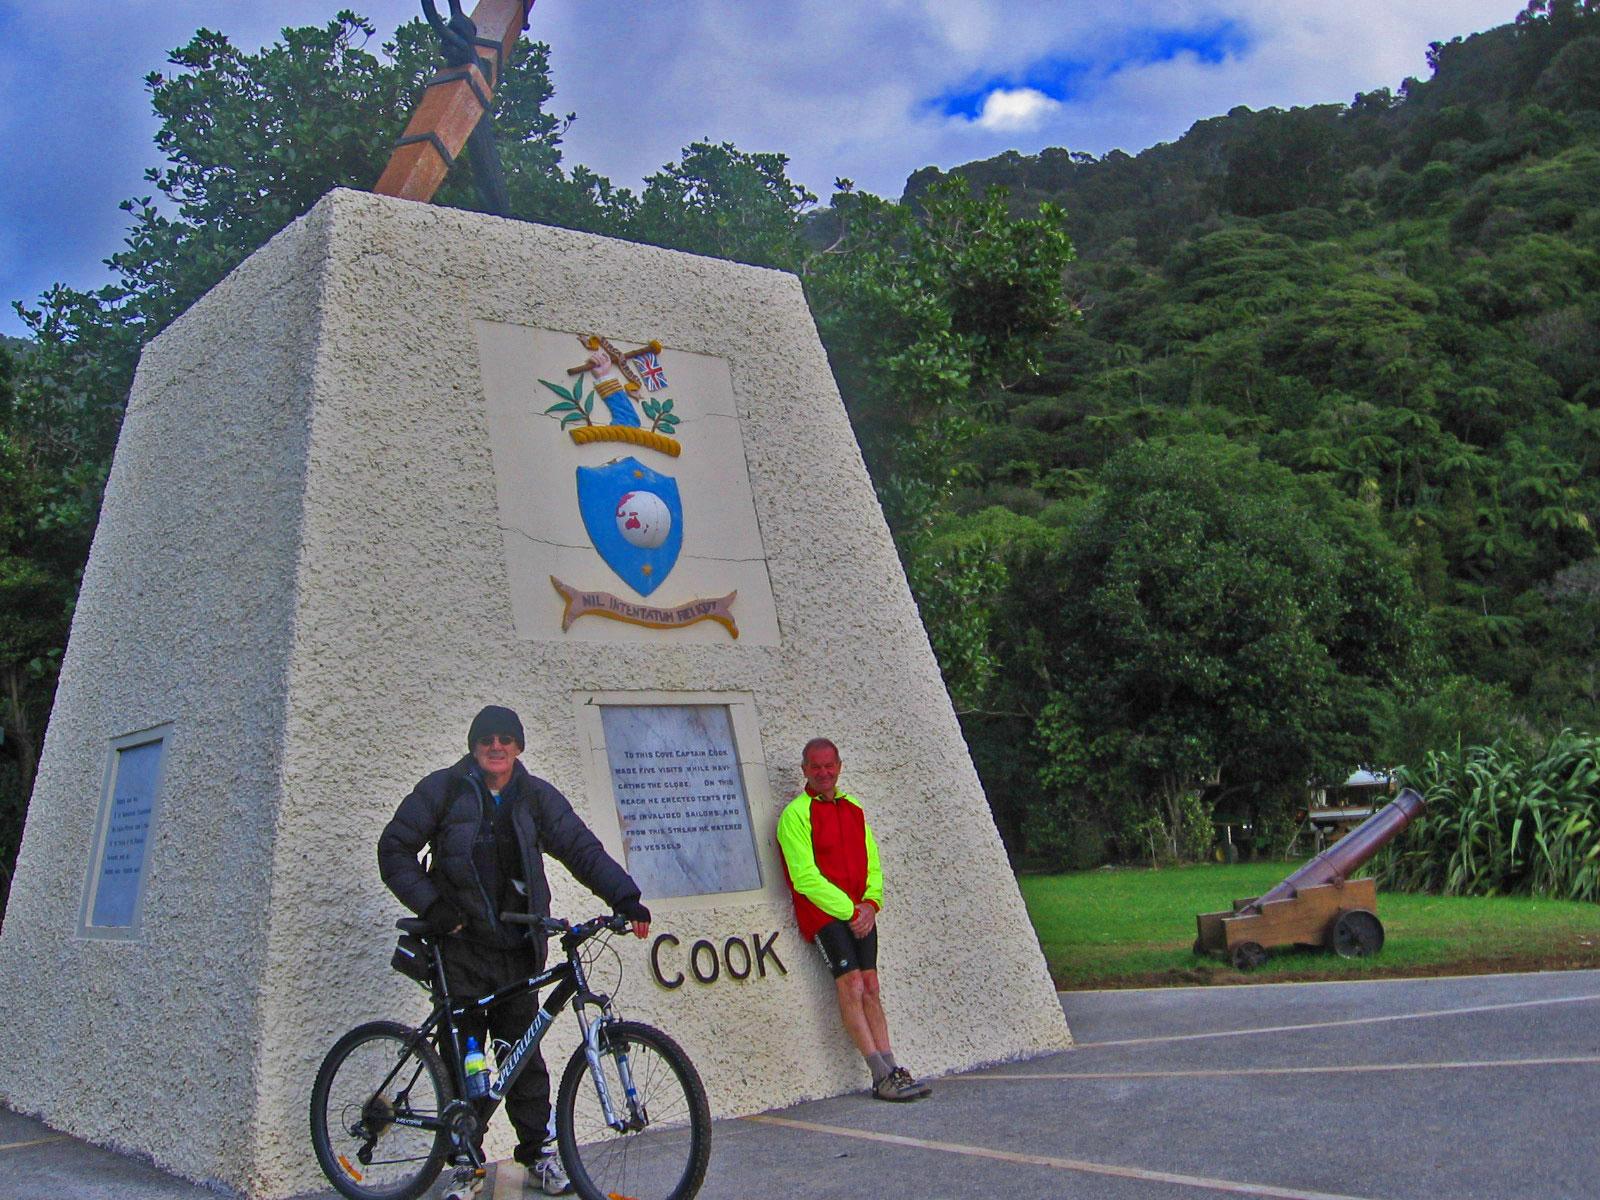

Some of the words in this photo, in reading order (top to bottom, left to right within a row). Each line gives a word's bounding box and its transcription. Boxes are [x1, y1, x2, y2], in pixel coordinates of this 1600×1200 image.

[582, 595, 605, 607] NIL
[636, 751, 653, 759] THIS
[655, 750, 674, 758] COVE
[675, 749, 706, 757] CAPTAIN
[708, 749, 728, 757] COOK
[704, 779, 715, 787] ON
[661, 796, 696, 804] ERECTED
[639, 812, 682, 821] INVALIDED
[626, 829, 647, 837] FROM
[667, 826, 697, 834] STREAM
[710, 823, 743, 832] WATERED
[650, 931, 788, 989] COOK
[496, 1013, 542, 1092] SPECIALIZED
